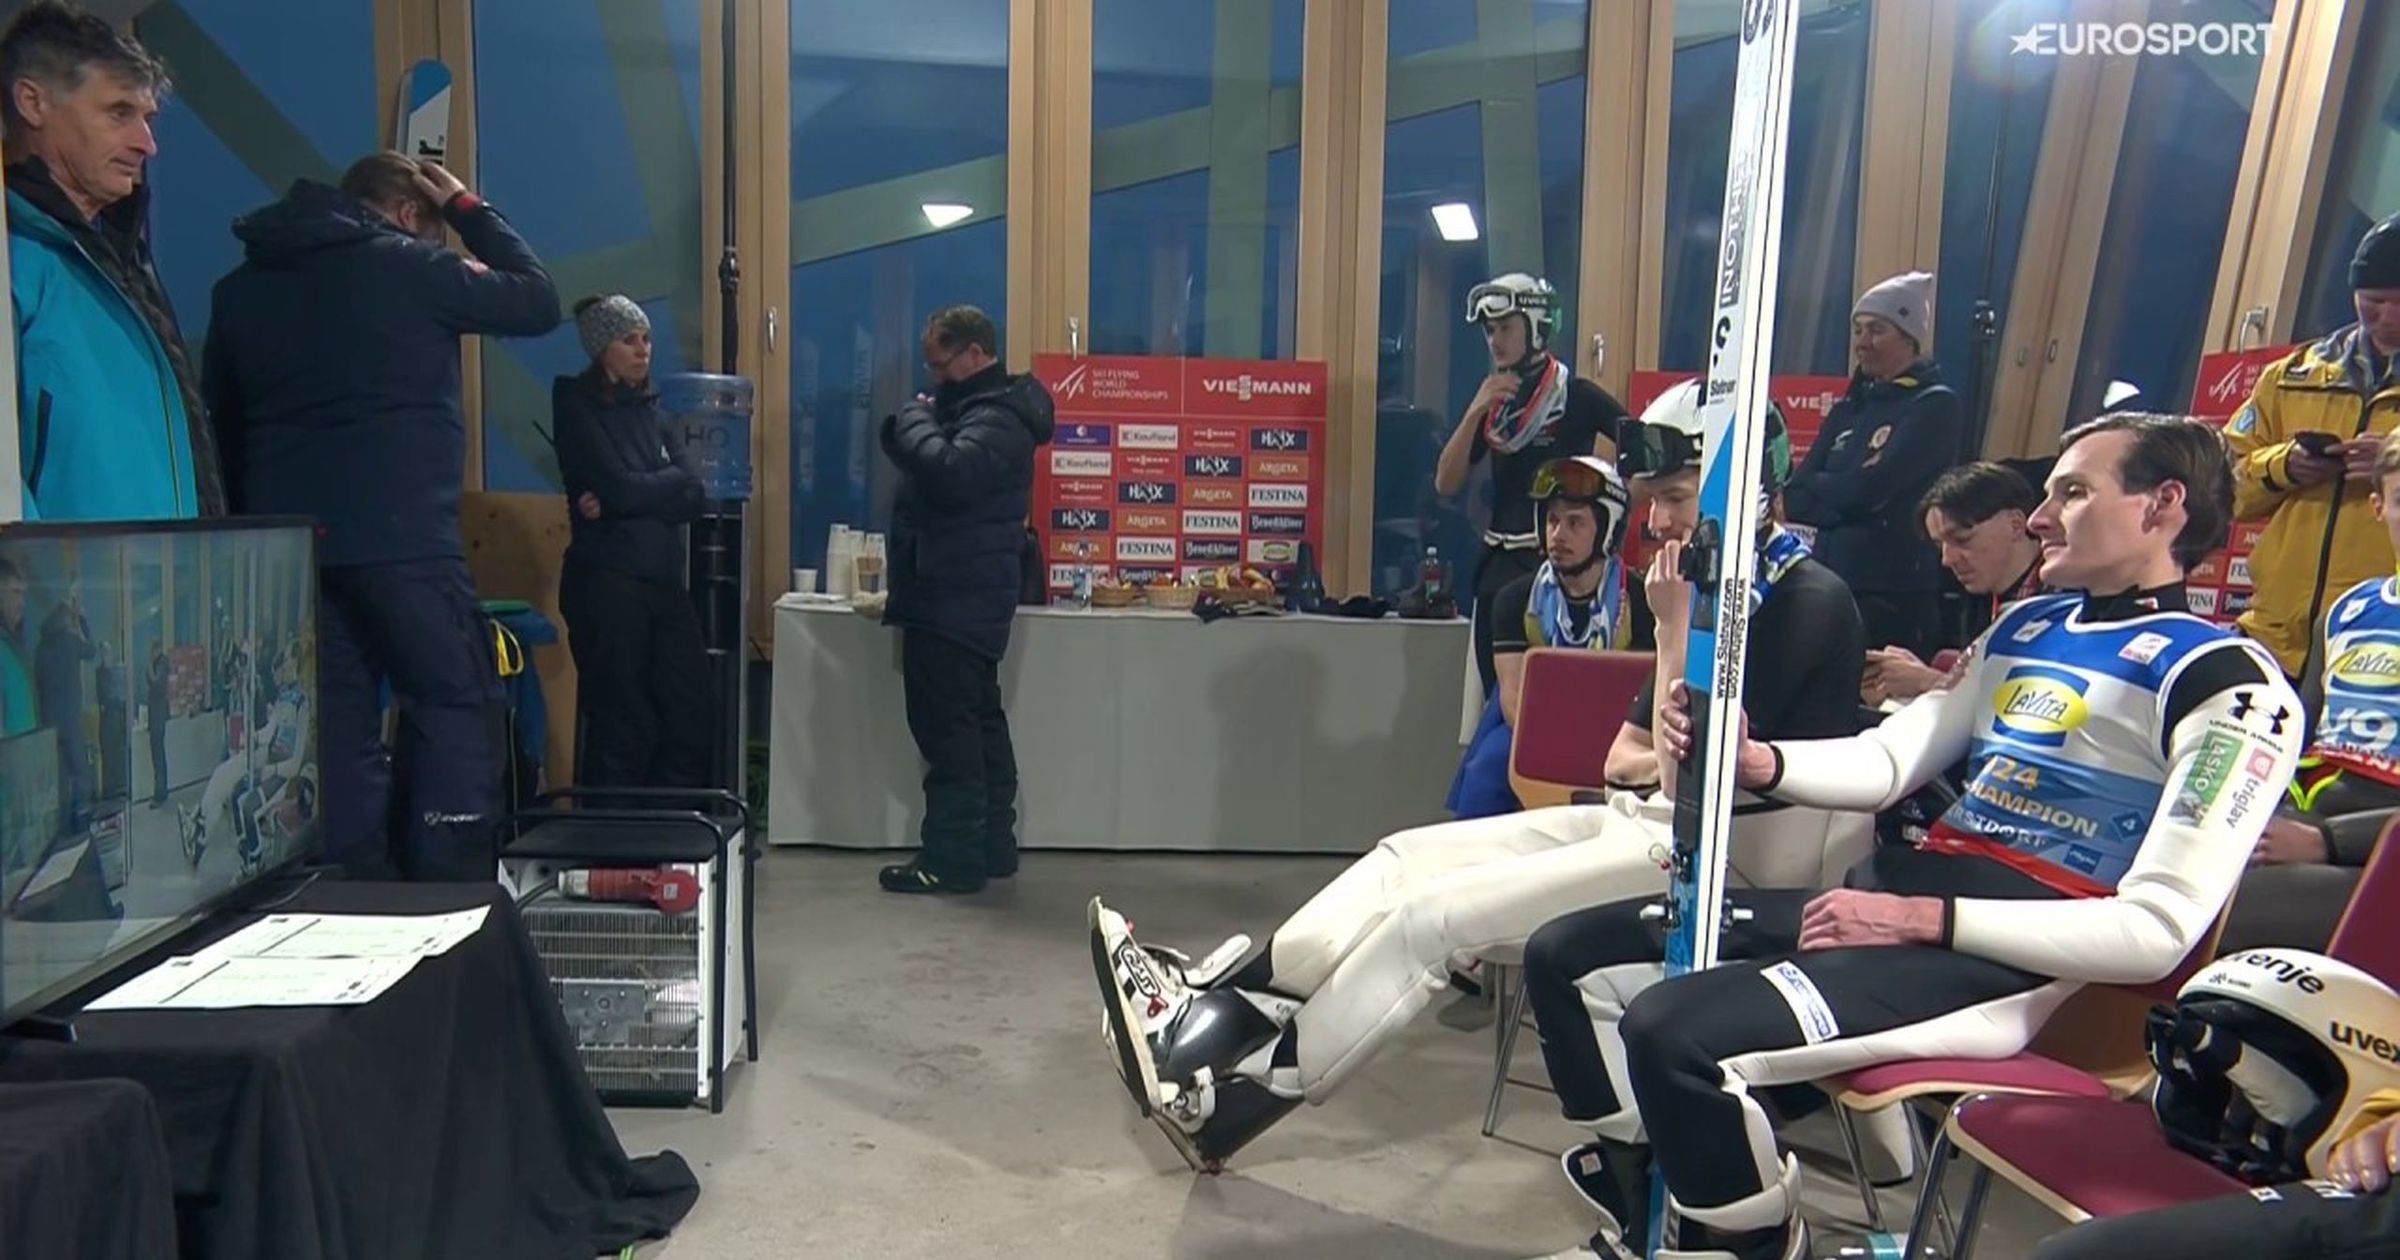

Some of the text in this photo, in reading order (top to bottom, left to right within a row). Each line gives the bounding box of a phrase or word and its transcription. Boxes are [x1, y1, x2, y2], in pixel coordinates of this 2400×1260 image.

[1108, 370, 1140, 379] FLYING
[1092, 380, 1127, 388] WORLD
[1203, 375, 1312, 400] VIESSMANN
[1092, 390, 1169, 400] CHAMPIONSHIPS
[1251, 488, 1305, 501] FESTINA
[1185, 515, 1239, 528] FESTINA
[1118, 542, 1173, 555] FESTINA
[2226, 779, 2261, 829] triglav
[2122, 818, 2137, 832] 4
